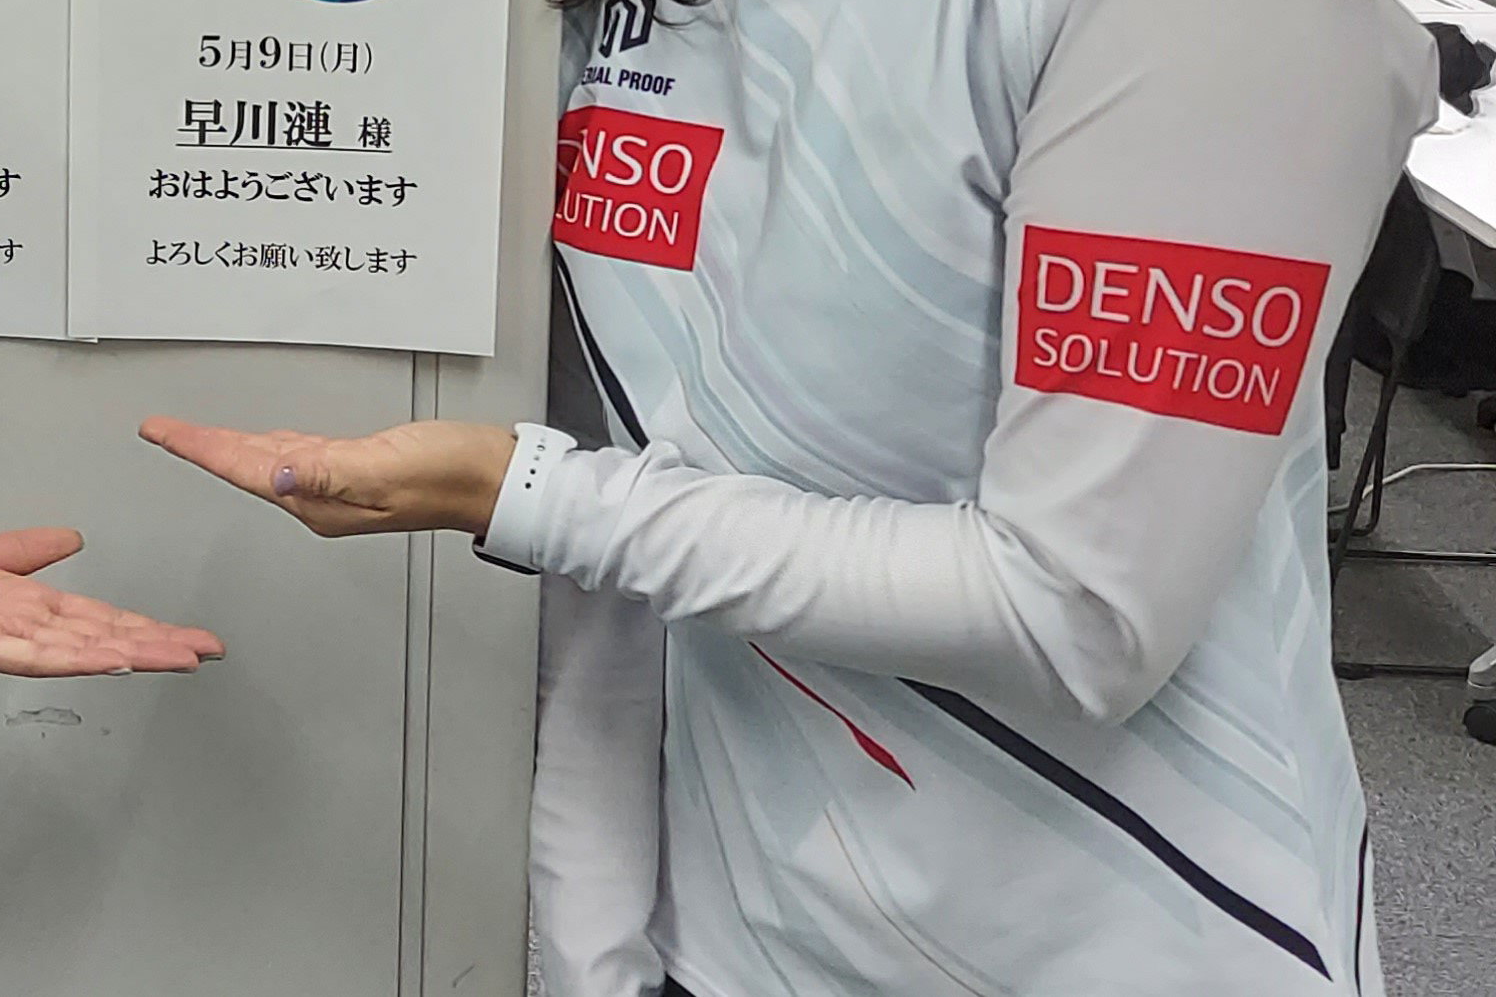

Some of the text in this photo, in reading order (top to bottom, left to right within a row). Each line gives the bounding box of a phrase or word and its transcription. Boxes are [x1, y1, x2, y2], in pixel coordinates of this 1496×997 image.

[198, 35, 373, 75] 5月9日(月)
[618, 69, 676, 97] PROOF
[358, 116, 392, 149] 様
[149, 168, 419, 208] おはようございます
[145, 239, 418, 275] よろしくお願い致します
[1036, 254, 1302, 347] DENSO
[1033, 328, 1281, 407] SOLUTION
